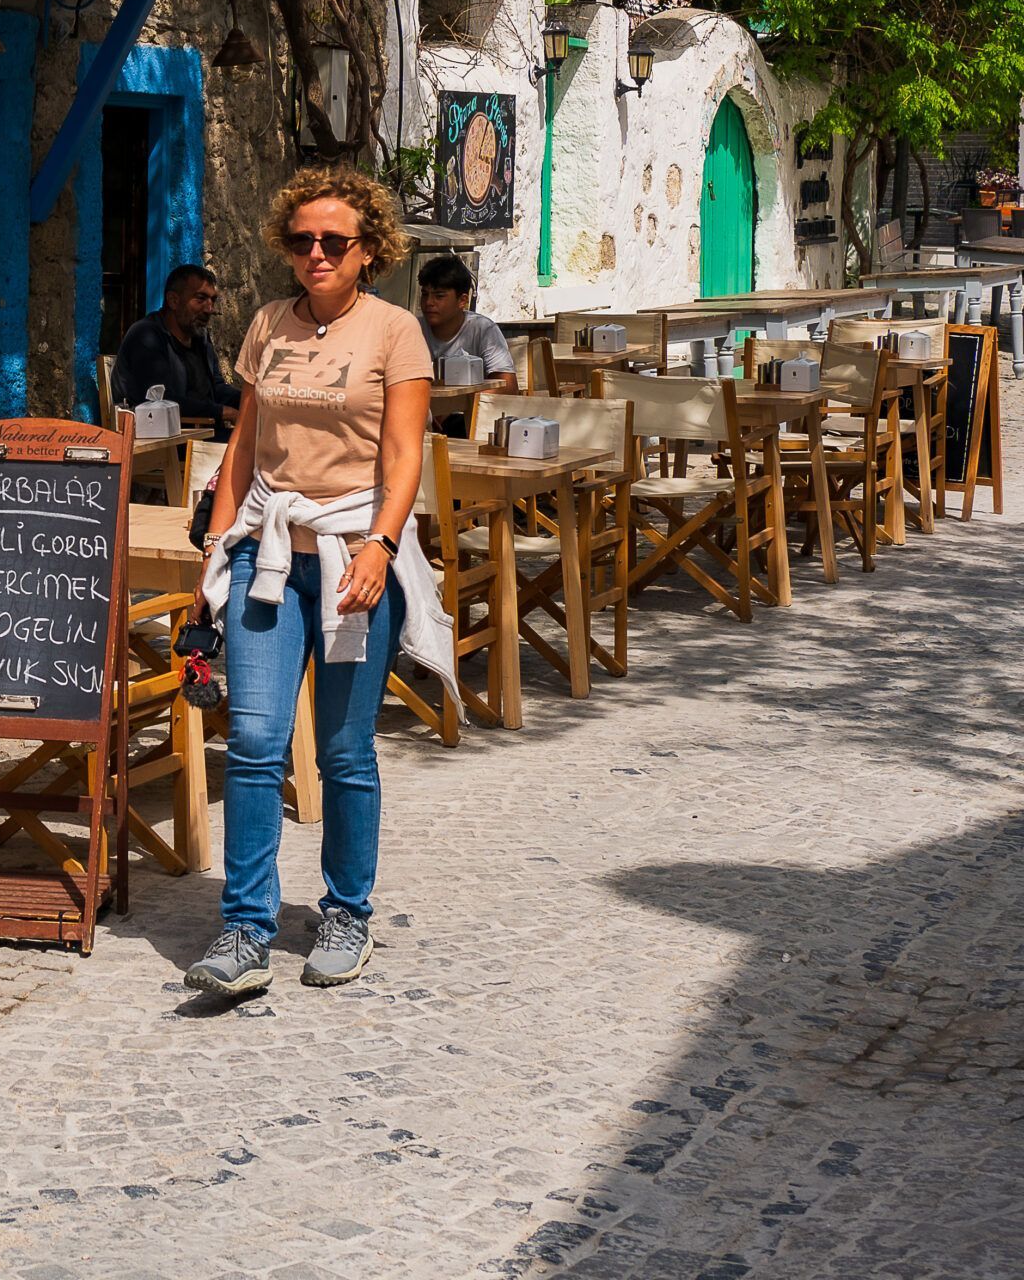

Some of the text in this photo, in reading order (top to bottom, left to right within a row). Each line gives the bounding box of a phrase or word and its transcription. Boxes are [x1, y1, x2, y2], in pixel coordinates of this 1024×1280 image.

[259, 386, 346, 403] new balance
[58, 429, 104, 444] wind
[16, 447, 23, 456] a
[27, 445, 61, 457] better
[31, 533, 108, 559] ÇORBA
